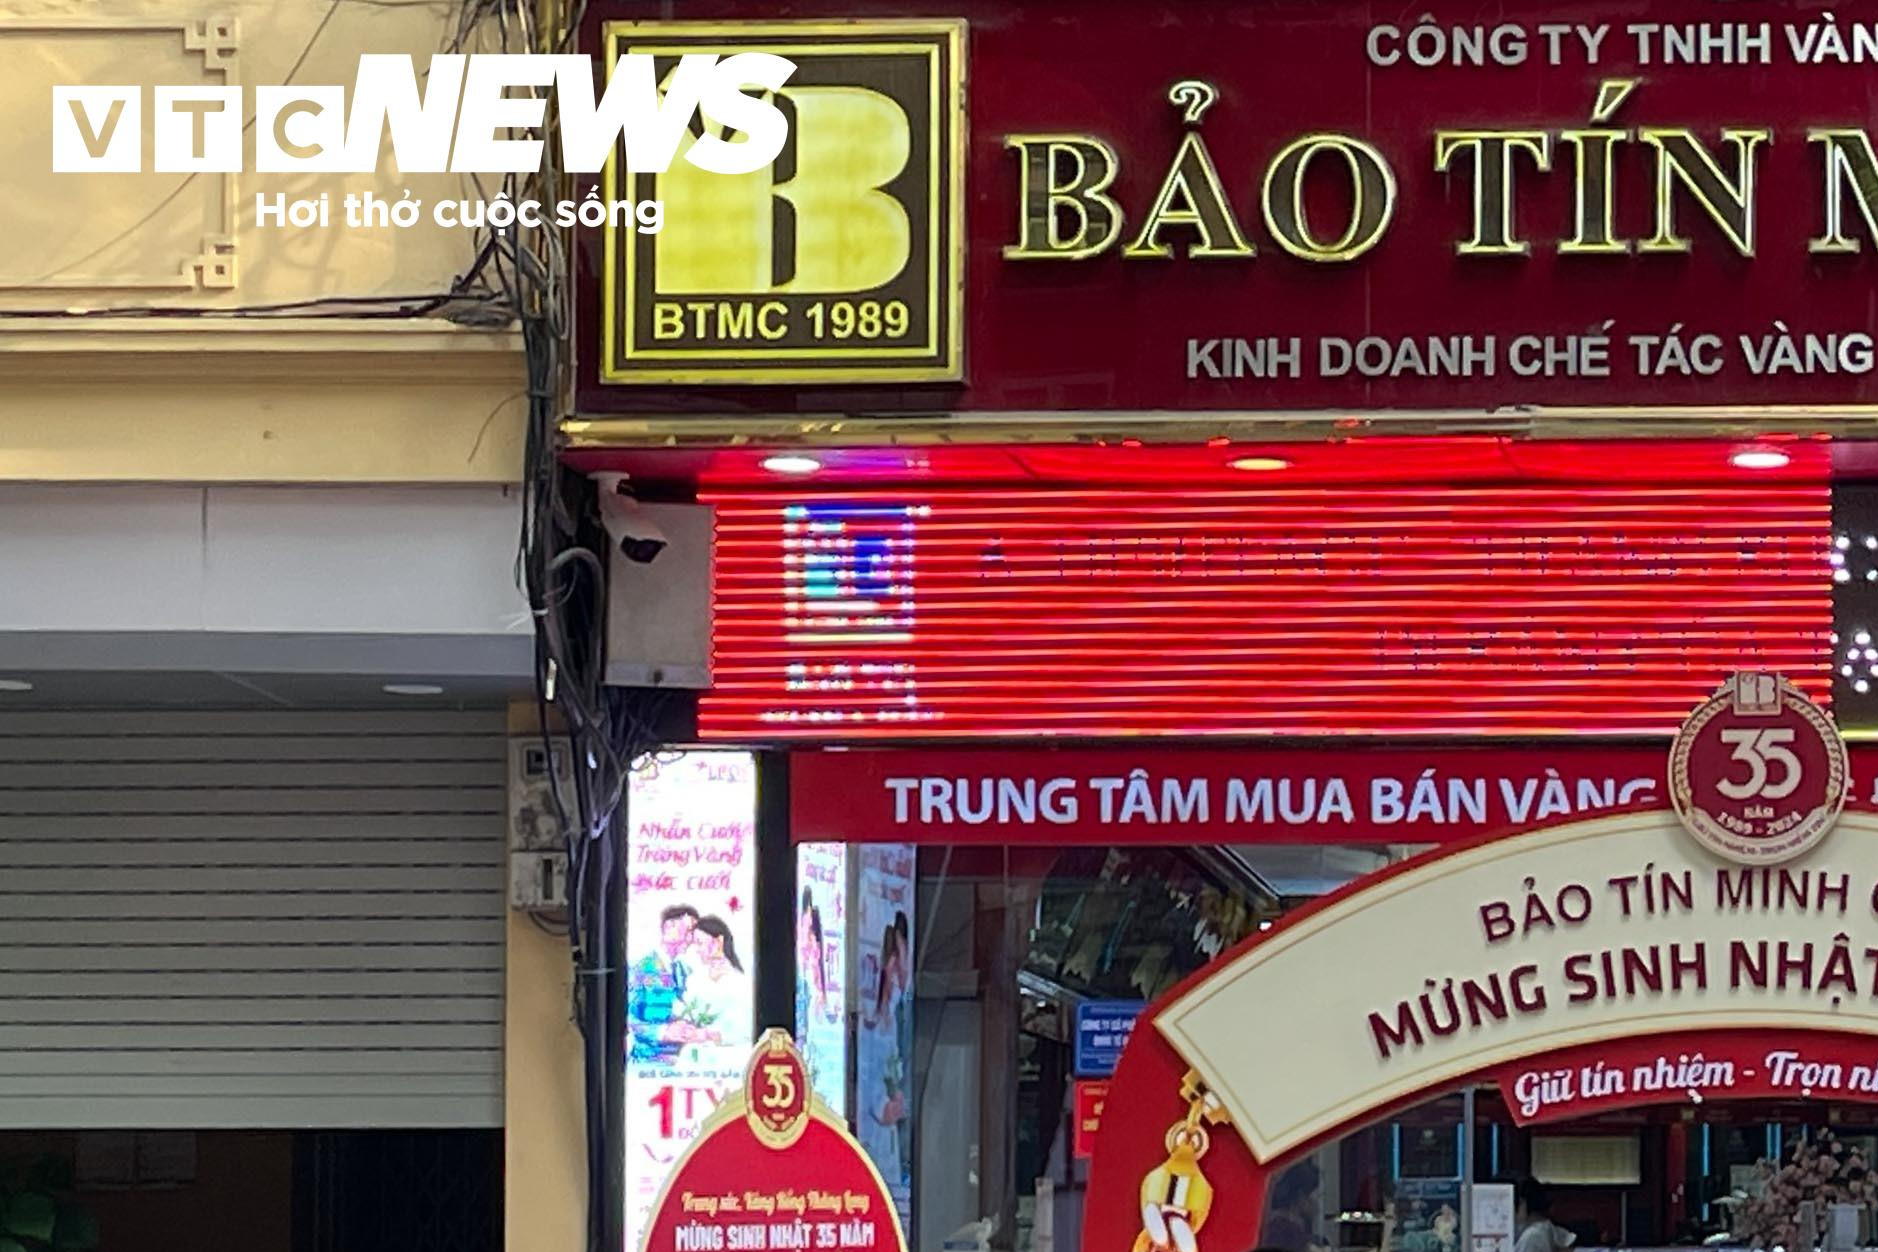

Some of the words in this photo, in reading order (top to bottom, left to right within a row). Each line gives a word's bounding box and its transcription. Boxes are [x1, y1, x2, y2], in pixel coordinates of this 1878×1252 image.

[1366, 12, 1528, 66] CÔNG
[1539, 24, 1610, 65] TY
[1628, 23, 1771, 65] TNHH
[1003, 80, 1398, 264] BẢO
[1434, 78, 1774, 259] TÍN
[653, 302, 790, 341] BTMC
[805, 302, 911, 340] 1989
[1185, 336, 1302, 380] KINH
[1319, 335, 1497, 378] DOANH
[1509, 318, 1616, 378] CHẾ
[1628, 323, 1725, 376] TÁC
[1740, 319, 1875, 375] VÀNG
[1715, 728, 1803, 800] 35
[884, 777, 1078, 825] TRUNG
[1090, 769, 1209, 824] TÂM
[1224, 777, 1354, 824] MUA
[1371, 768, 1488, 824] BÁN
[1479, 876, 1595, 944] BẢO
[1607, 862, 1695, 919] TÍN
[1716, 867, 1851, 915] MINH
[1366, 962, 1549, 1060] MỪNG
[1562, 942, 1709, 1006] SINH
[761, 1064, 796, 1109] 35
[1514, 1070, 1575, 1118] Giữ
[1579, 1057, 1628, 1102] tín
[1632, 1052, 1736, 1104] nhiệm
[1763, 1050, 1844, 1098] Trọn
[674, 1219, 725, 1252] MỪNG
[726, 1222, 768, 1251] SINH
[815, 1222, 838, 1249] 35
[839, 1217, 876, 1249] NĂM
